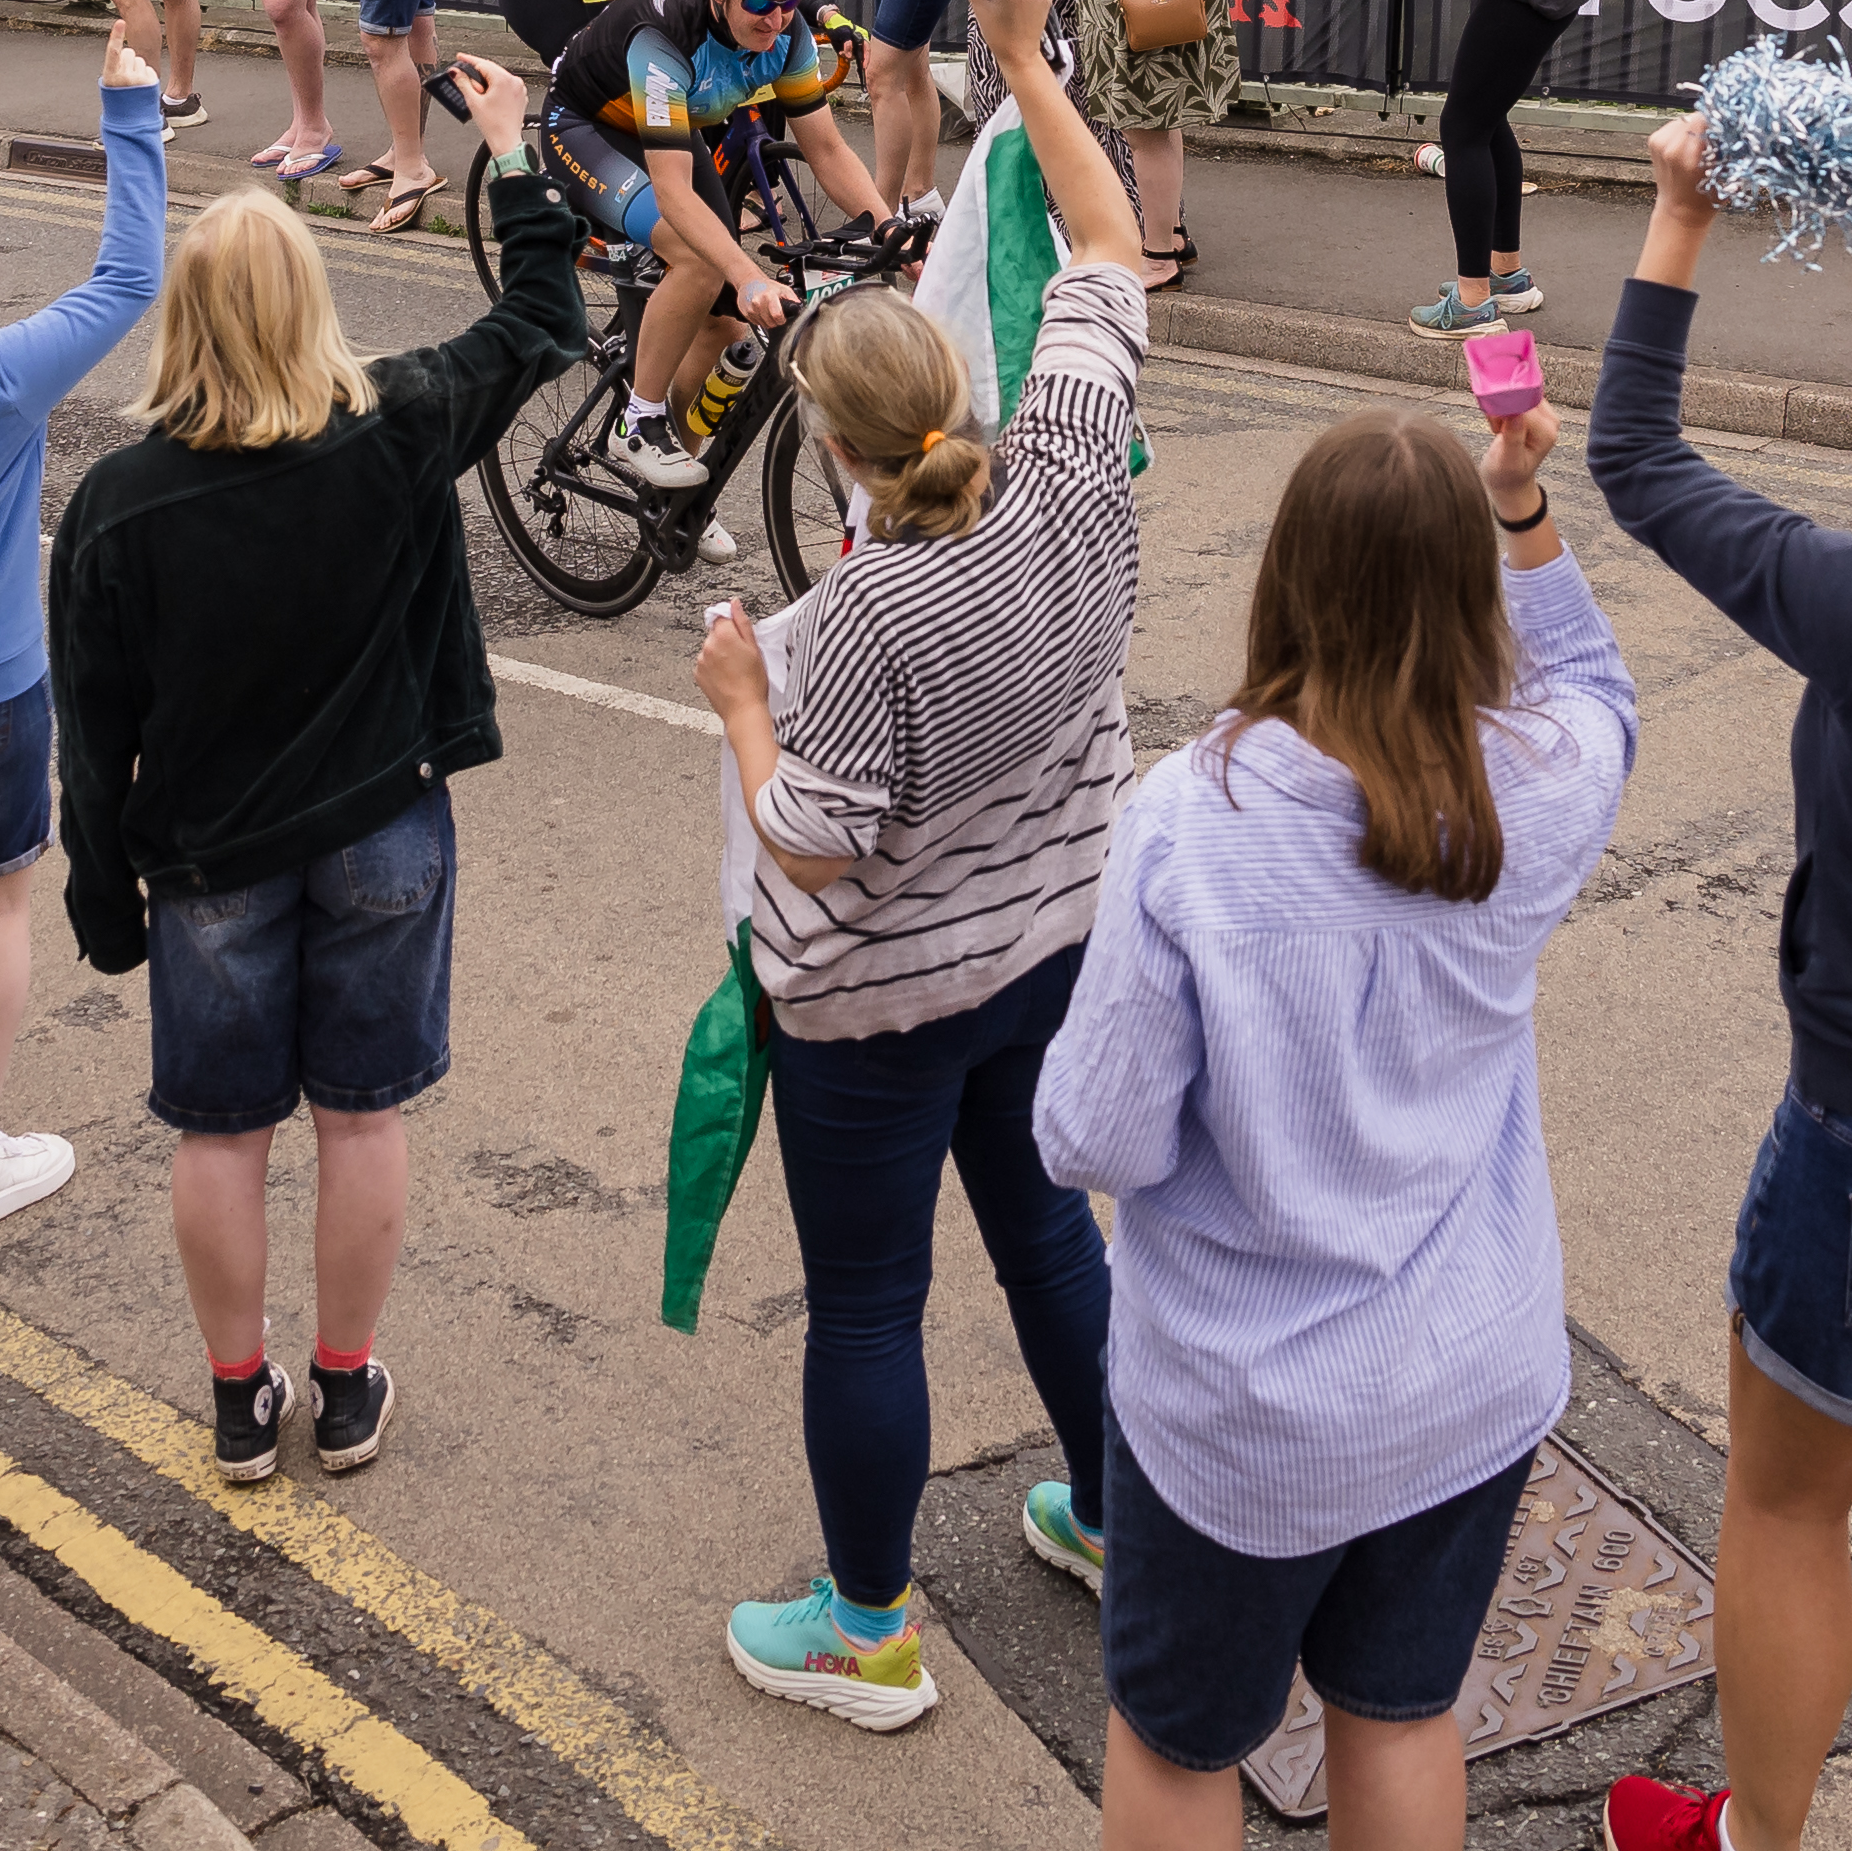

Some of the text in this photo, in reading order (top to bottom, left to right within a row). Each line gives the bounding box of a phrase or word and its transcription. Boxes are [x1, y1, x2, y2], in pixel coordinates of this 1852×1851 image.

[549, 133, 608, 195] HARDEST
[1538, 1530, 1636, 1704] CHIEFTAIN 600
[803, 1651, 863, 1677] HOKA
